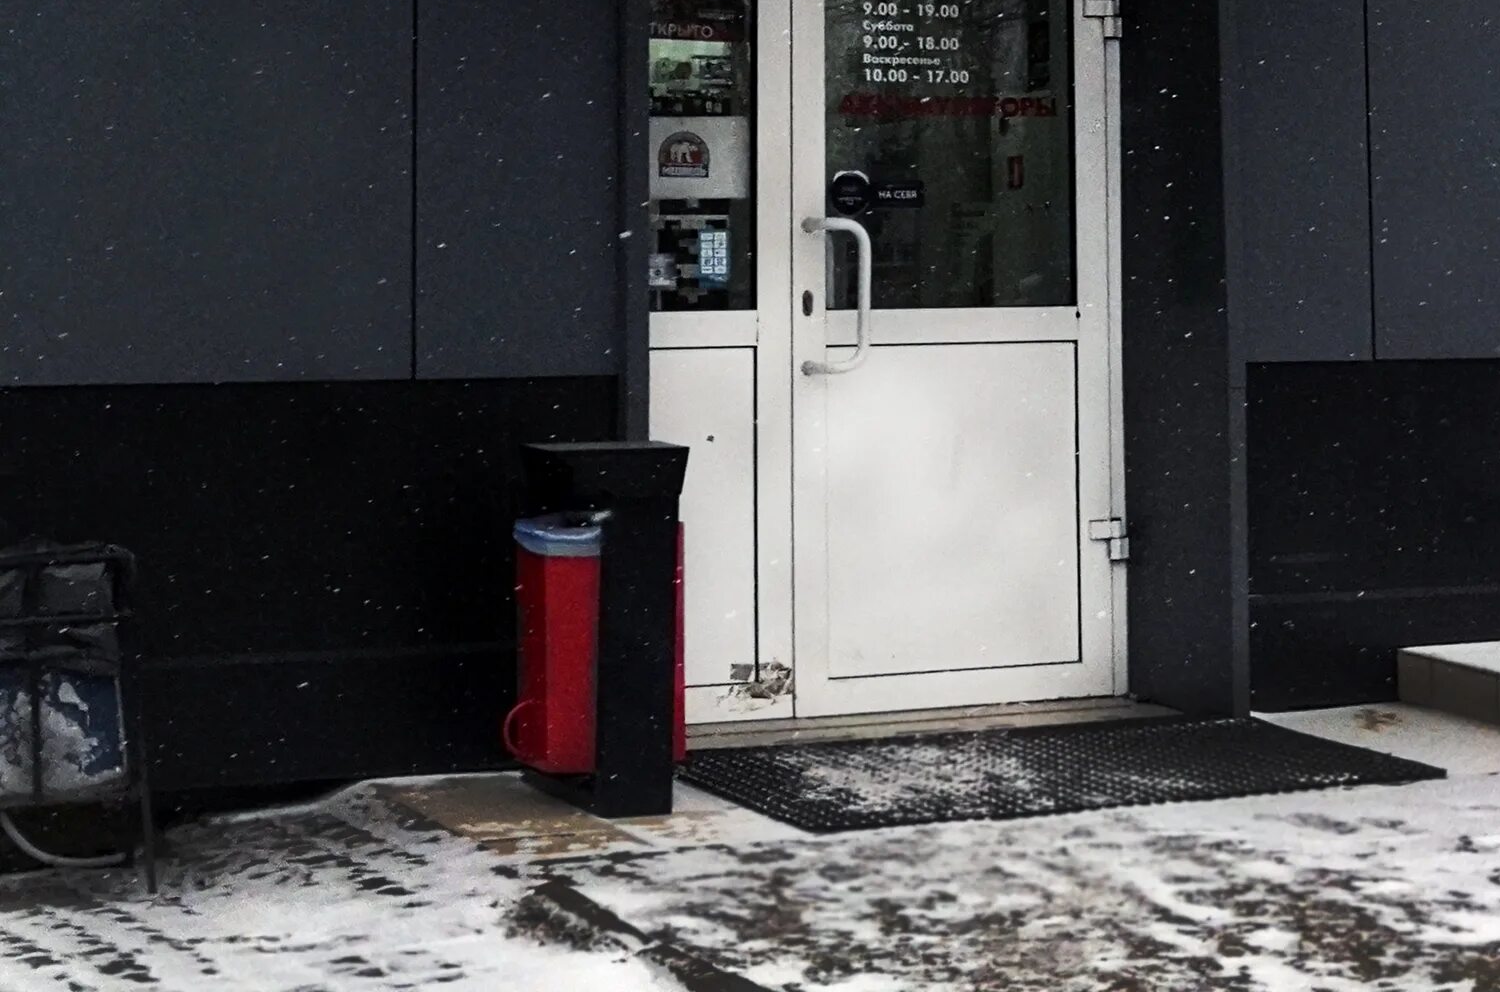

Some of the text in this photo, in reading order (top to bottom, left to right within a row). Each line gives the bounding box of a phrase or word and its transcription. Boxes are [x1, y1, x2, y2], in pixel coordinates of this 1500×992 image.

[863, 2, 898, 16] 9.00
[917, 3, 960, 18] 19.00
[862, 20, 914, 32] Суббота
[863, 35, 898, 50] 9.00
[917, 36, 960, 51] 18.00
[863, 54, 941, 67] Воскресенье
[864, 68, 907, 83] 10.00
[927, 70, 970, 84] 17.00
